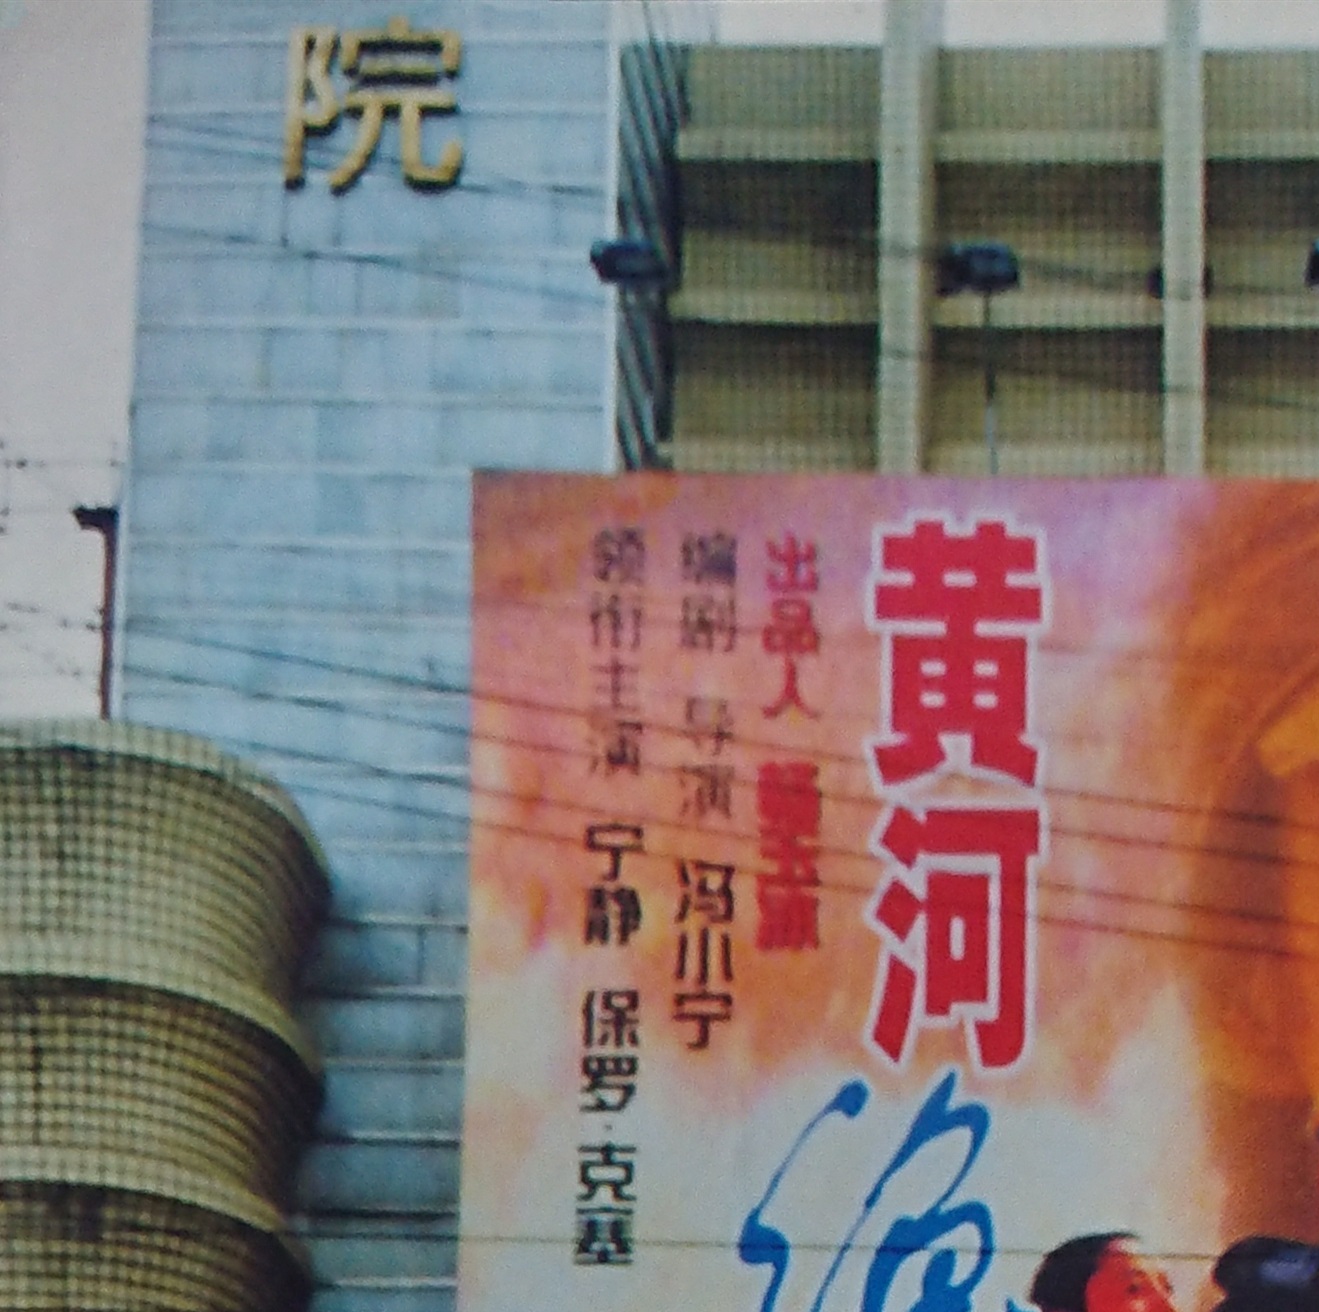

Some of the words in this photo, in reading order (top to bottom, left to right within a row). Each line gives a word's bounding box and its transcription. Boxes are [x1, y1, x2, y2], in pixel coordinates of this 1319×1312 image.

[283, 15, 463, 196] 院
[763, 533, 819, 719] 出品人
[583, 822, 644, 946] 宁静
[672, 860, 737, 1050] 冯小宁
